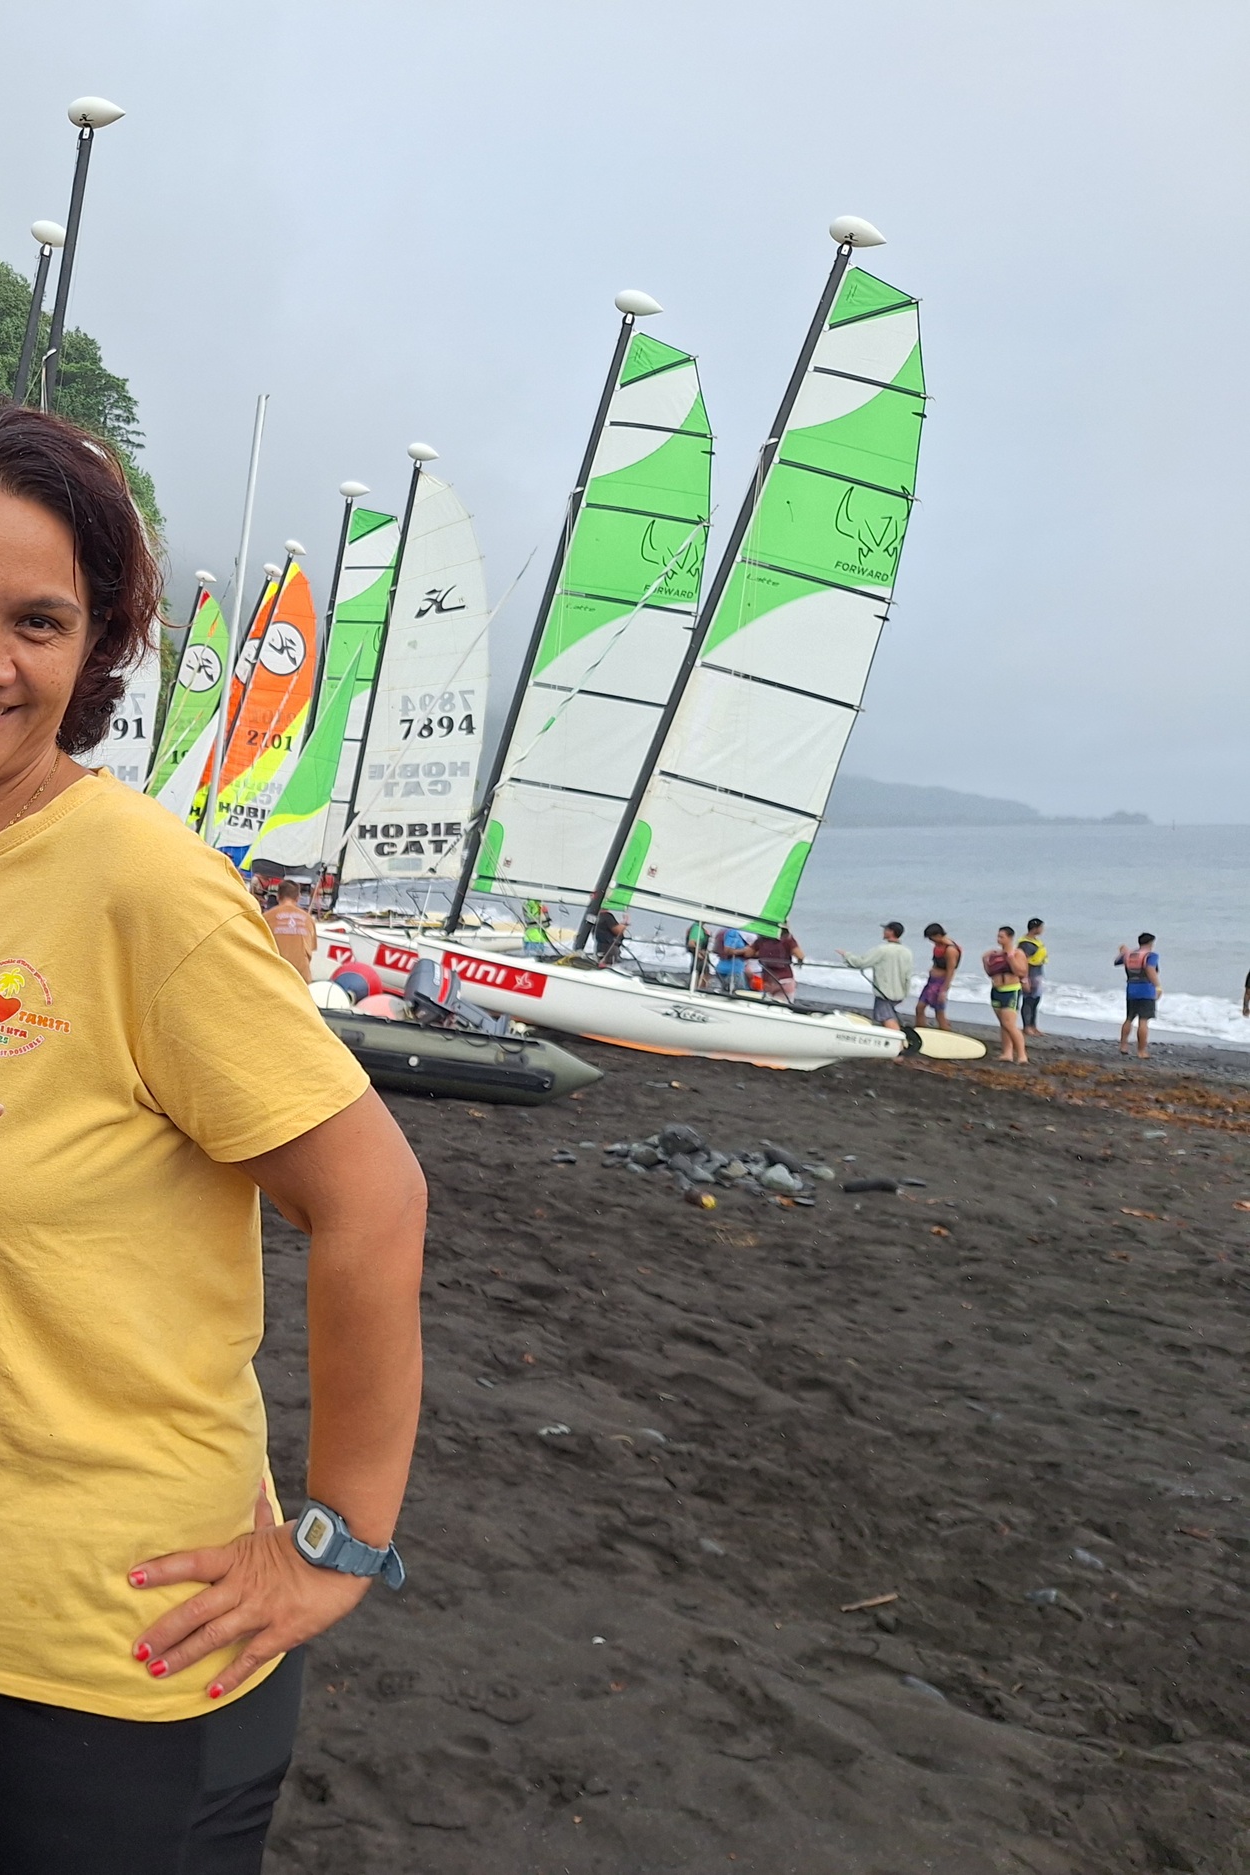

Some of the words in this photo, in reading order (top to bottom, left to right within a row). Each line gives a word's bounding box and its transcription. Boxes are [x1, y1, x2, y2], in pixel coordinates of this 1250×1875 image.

[834, 561, 889, 583] FORWARD
[643, 584, 694, 599] FRWARD
[400, 714, 476, 740] 7894
[246, 730, 292, 752] 2101
[218, 801, 270, 820] HOBI
[358, 822, 461, 840] HOBIE
[374, 839, 448, 857] CAT
[0, 1024, 5, 1033] I
[6, 1026, 28, 1038] UTA
[19, 1011, 70, 1033] TAHITI
